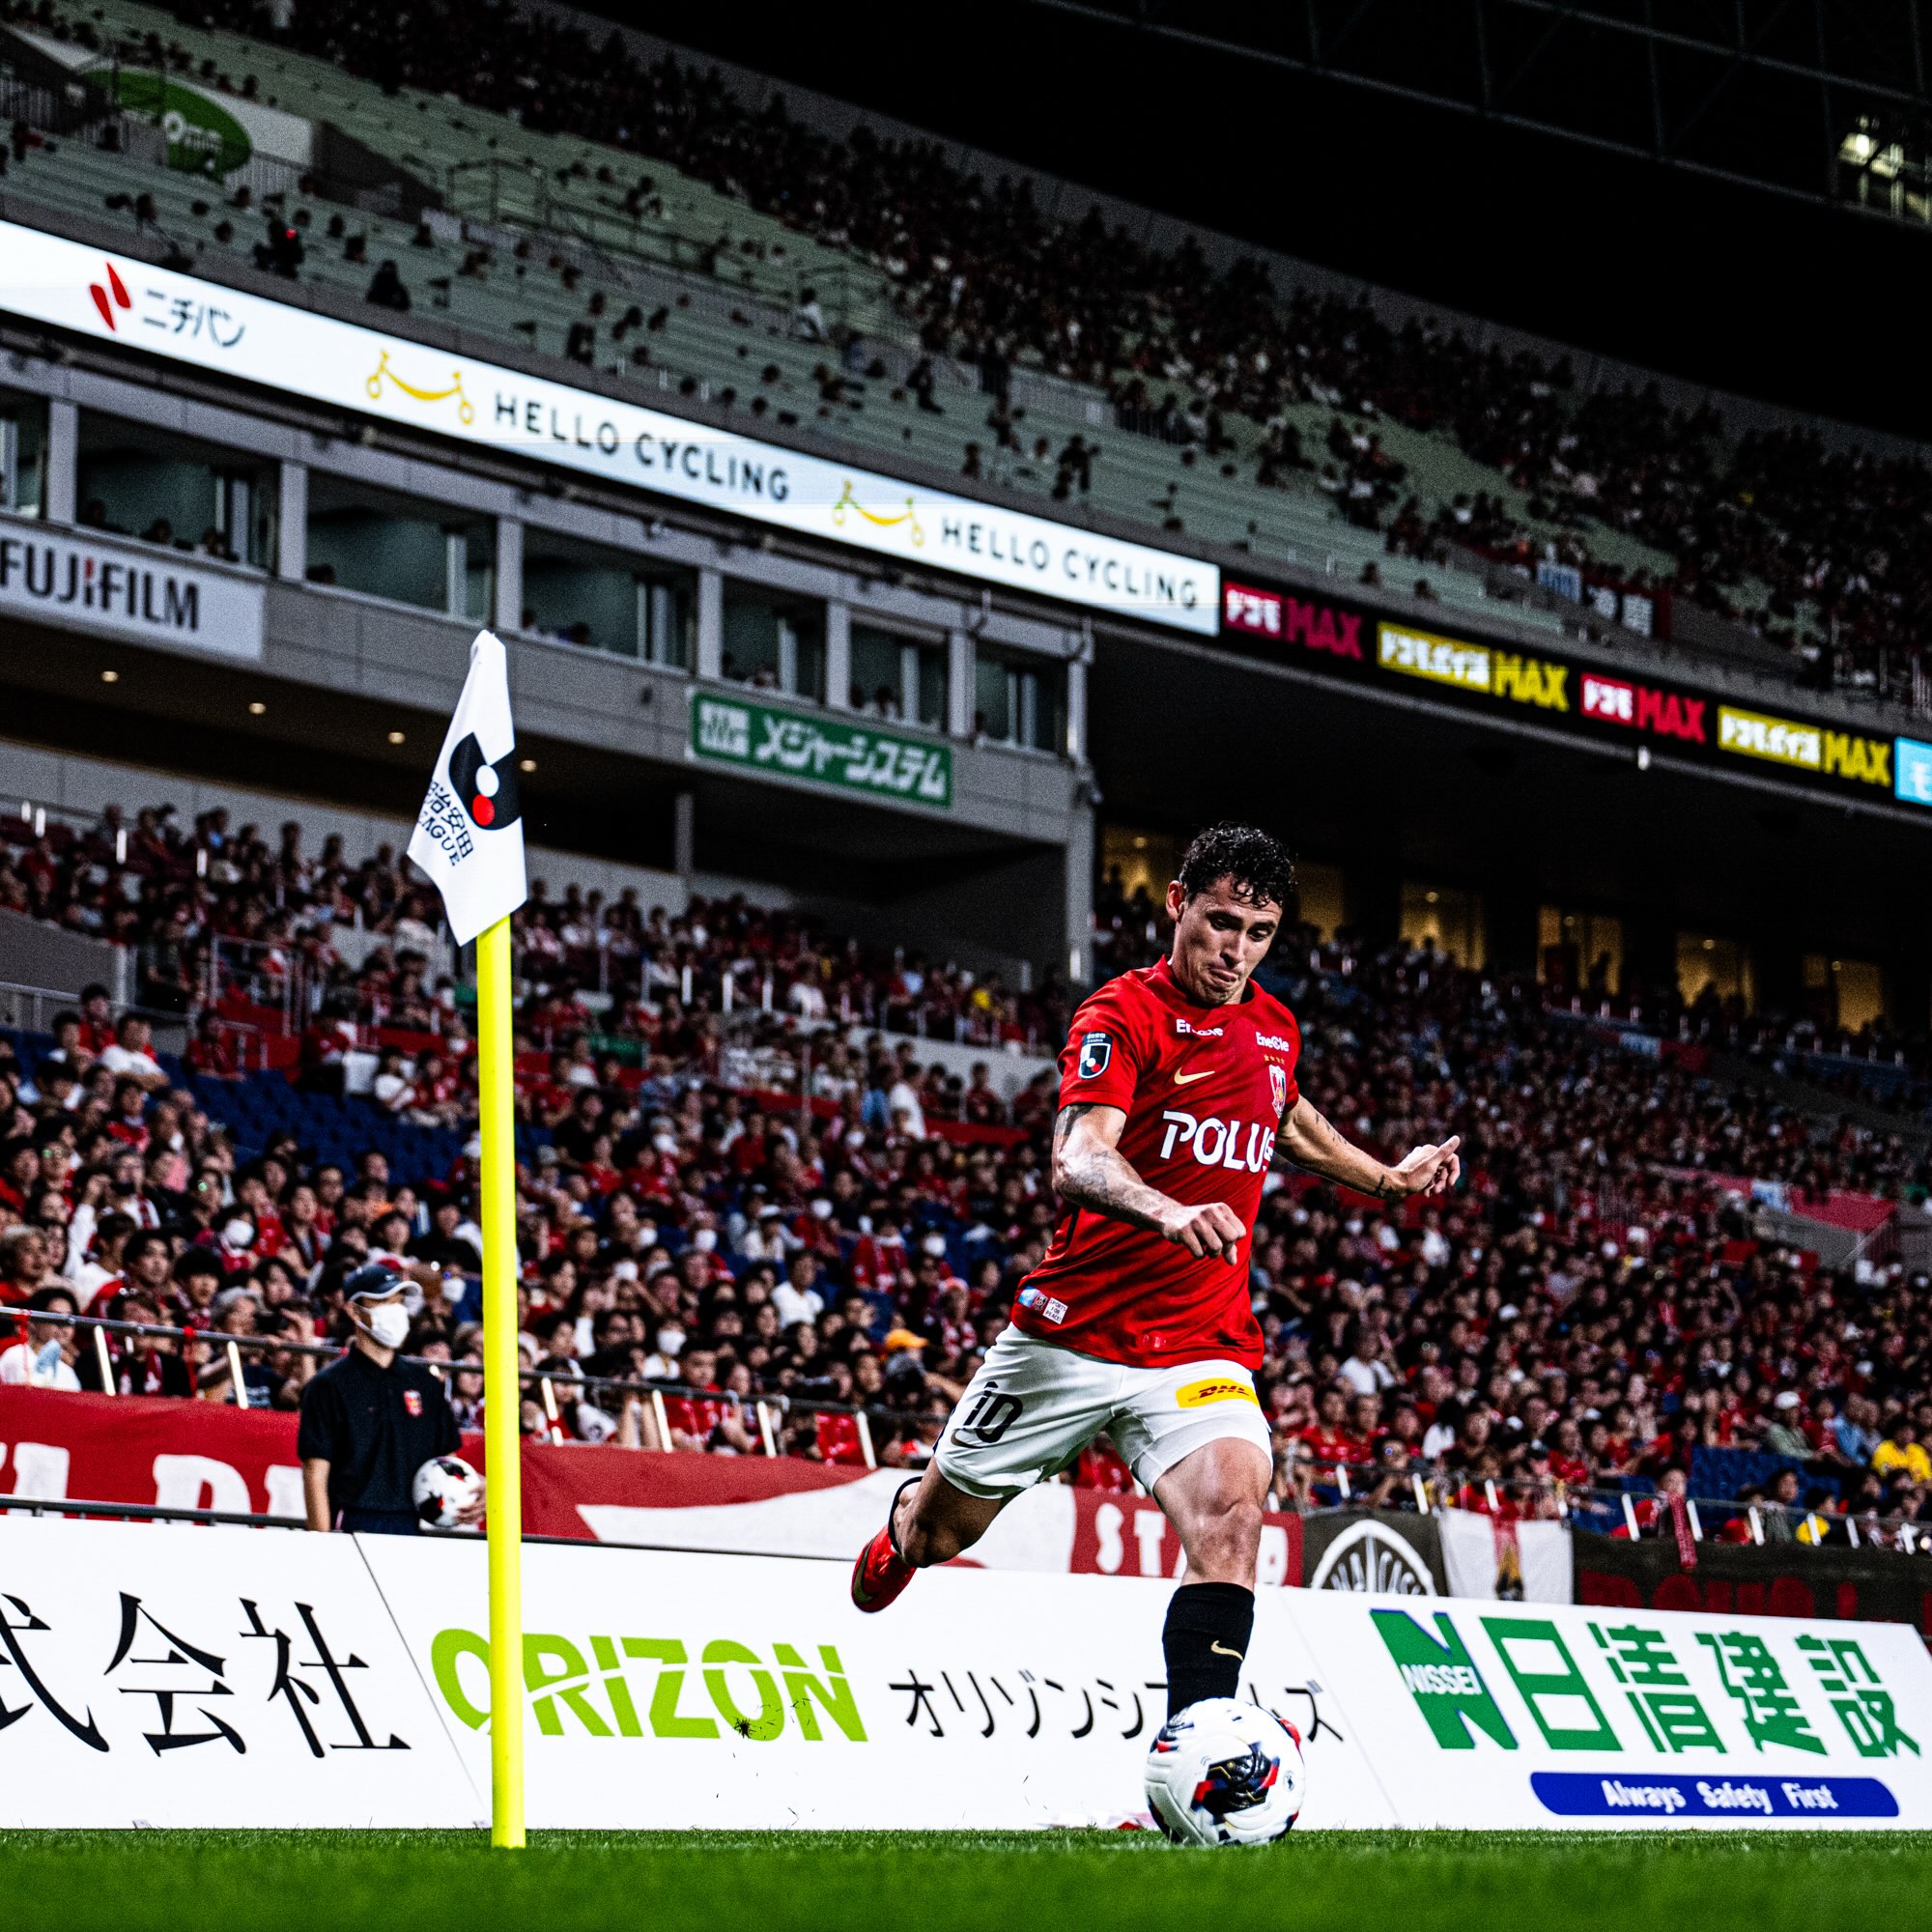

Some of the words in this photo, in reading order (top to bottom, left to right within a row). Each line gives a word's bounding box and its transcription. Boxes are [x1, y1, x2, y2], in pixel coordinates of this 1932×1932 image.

[143, 289, 246, 348] ニチバン
[495, 390, 619, 456] HELLO
[634, 432, 790, 501] CYCLING
[0, 537, 200, 634] FUJIFILM
[941, 515, 1050, 571] HELLO
[1063, 548, 1198, 610] CYCLING
[1287, 595, 1364, 662] MAX
[1494, 649, 1571, 713] MAX
[1637, 685, 1708, 744] MAX
[1823, 730, 1892, 788] MAX
[1198, 1385, 1250, 1399] DHL
[431, 1628, 868, 1743] ORIZON
[888, 1668, 1345, 1741] オリゾンシズ
[1400, 1662, 1483, 1695] NISSEI
[1480, 1616, 1921, 1758] 日清建設
[1601, 1779, 1687, 1814] Always
[1696, 1780, 1774, 1815] Safety
[1780, 1782, 1839, 1809] First
